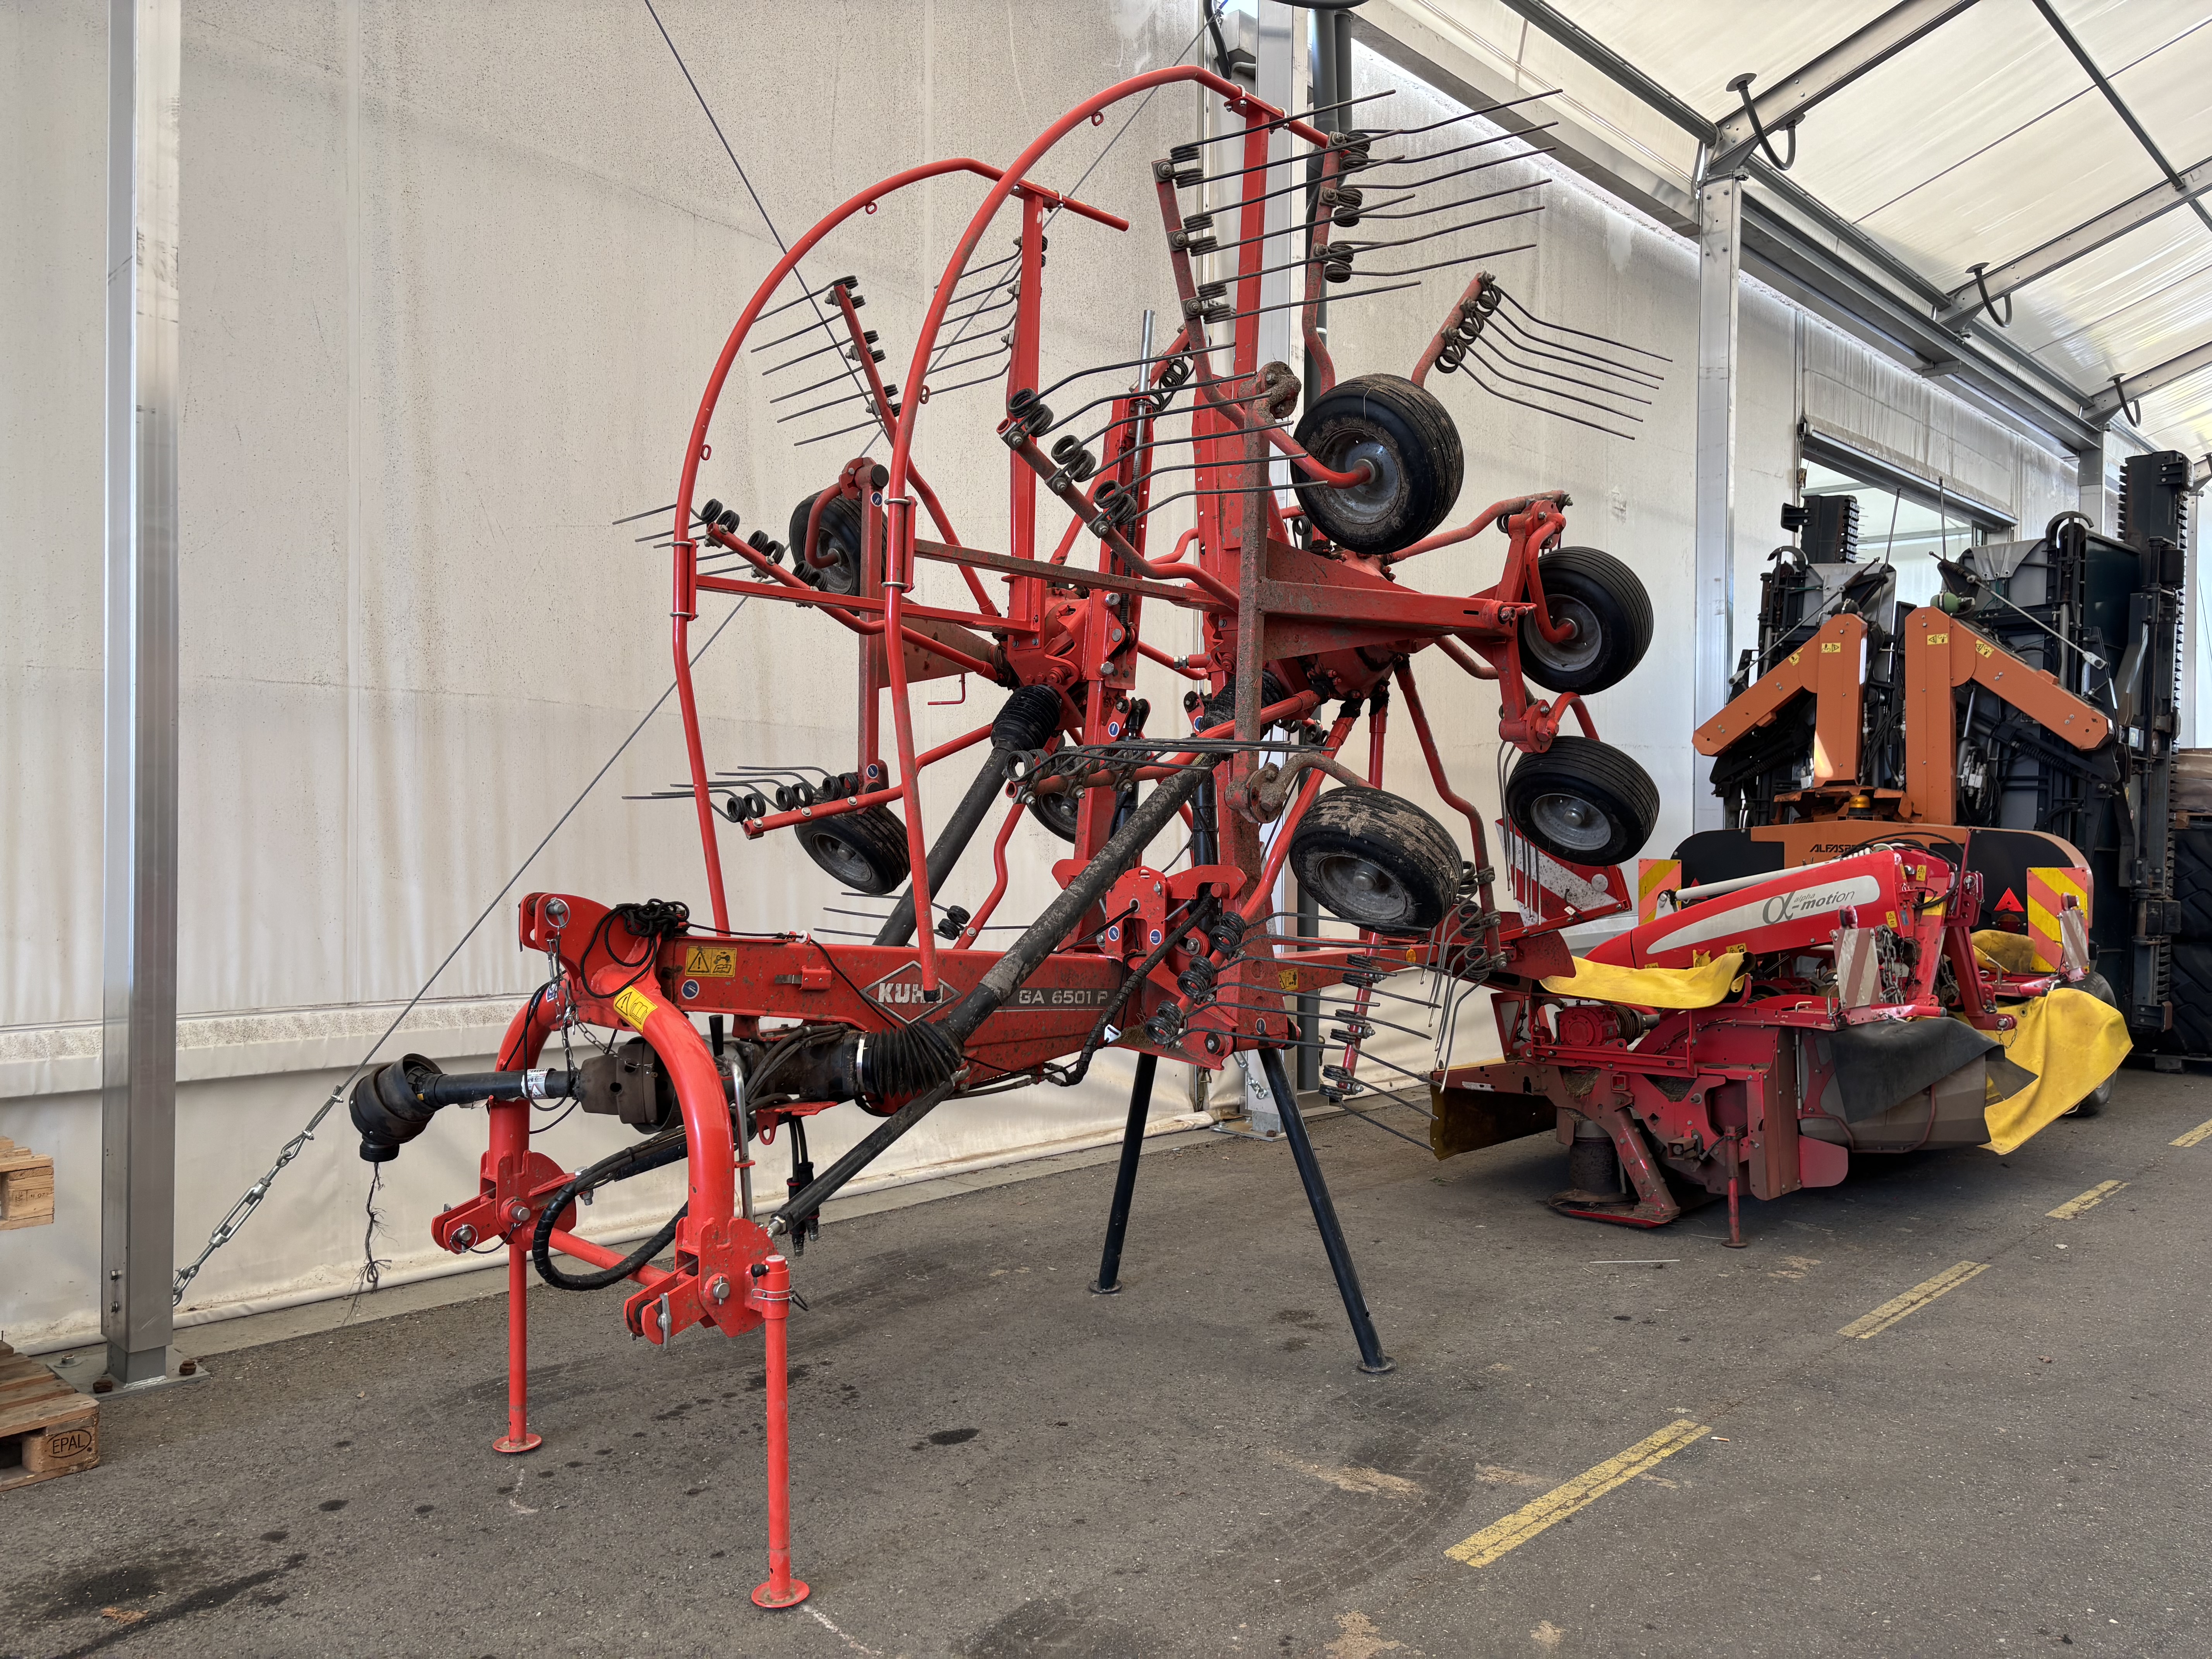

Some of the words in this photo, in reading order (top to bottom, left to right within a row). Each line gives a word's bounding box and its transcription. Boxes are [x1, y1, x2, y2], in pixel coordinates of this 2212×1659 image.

[1794, 893, 1815, 903] alpha
[1019, 990, 1045, 1004] GA
[1052, 990, 1091, 1004] 6501
[1097, 990, 1108, 1004] P
[53, 1434, 85, 1454] EPAL
